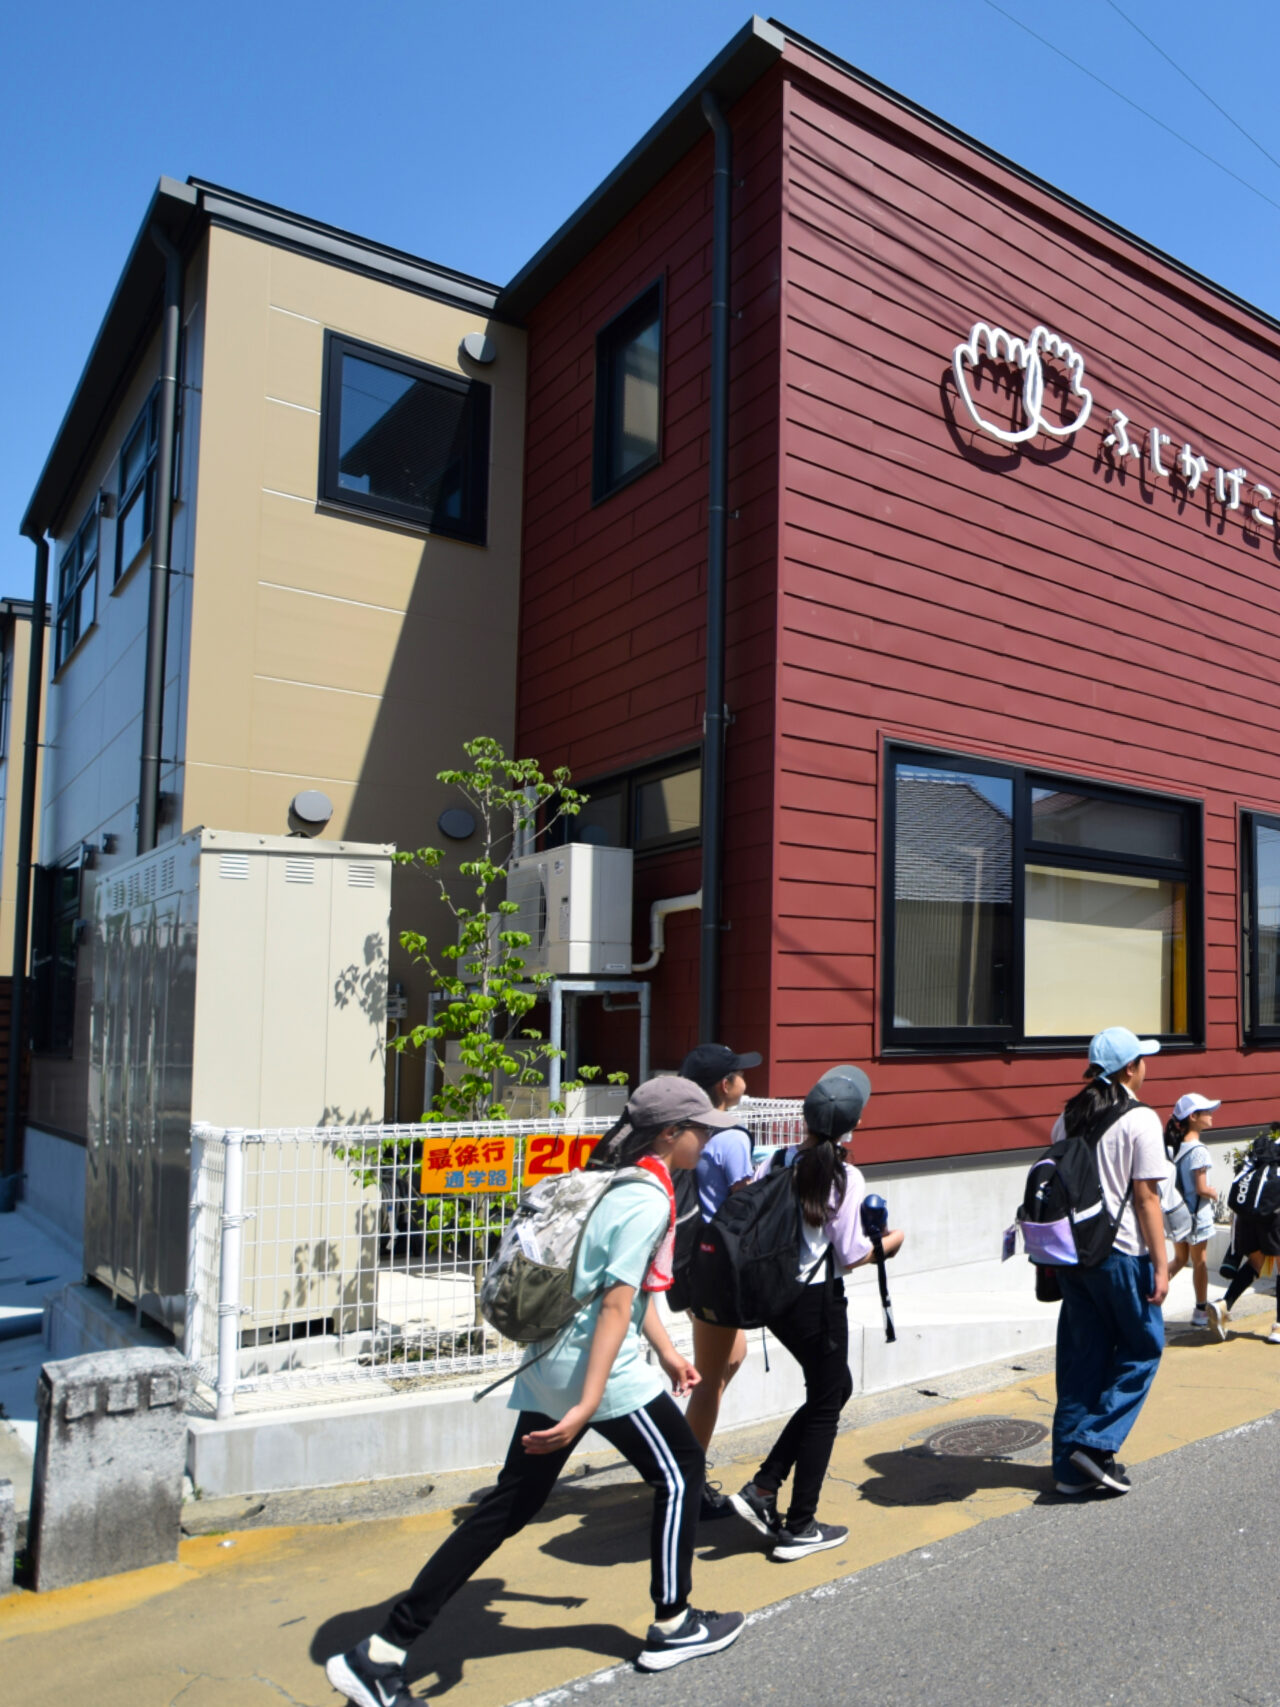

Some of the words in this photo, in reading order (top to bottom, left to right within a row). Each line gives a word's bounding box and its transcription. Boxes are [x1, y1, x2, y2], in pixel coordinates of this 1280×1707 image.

[427, 1141, 506, 1170] 最徐行
[528, 1137, 601, 1174] 20
[444, 1169, 507, 1188] 通学路
